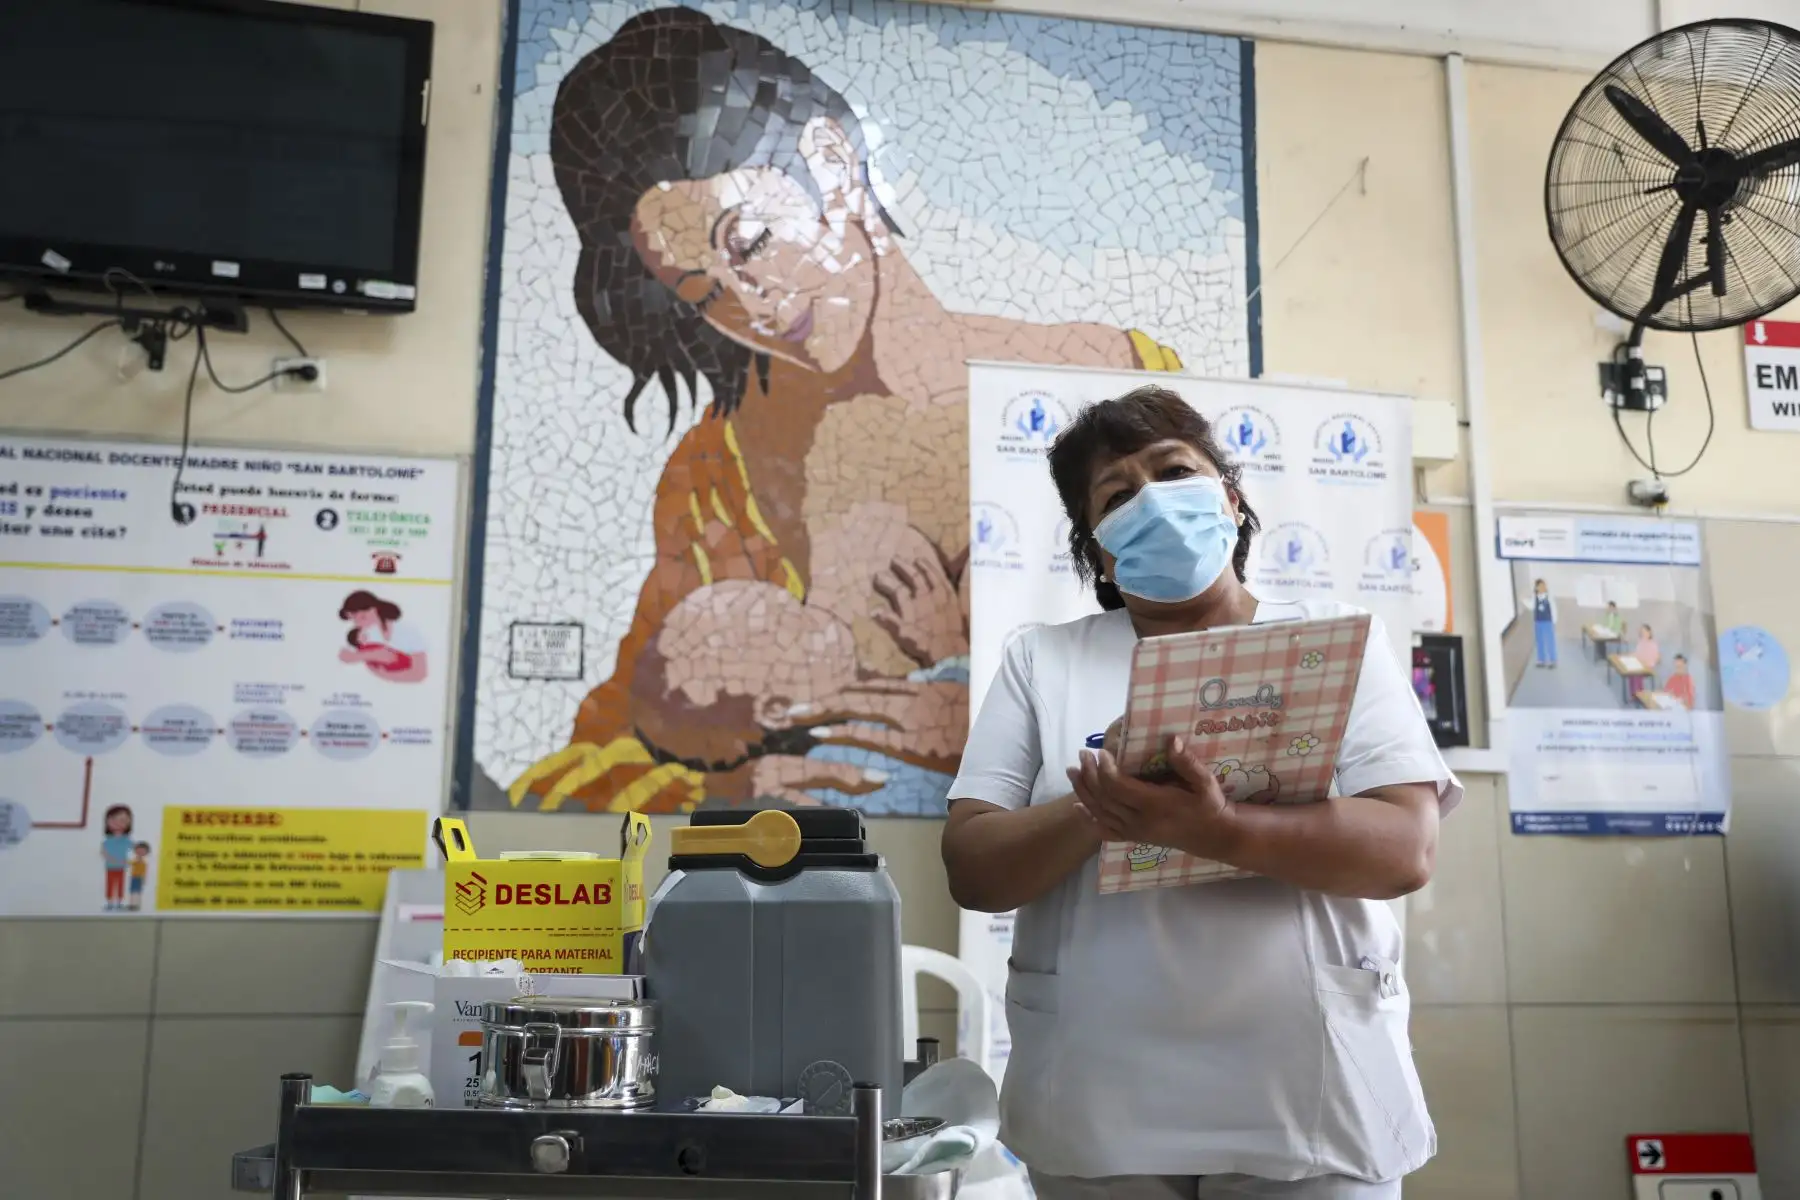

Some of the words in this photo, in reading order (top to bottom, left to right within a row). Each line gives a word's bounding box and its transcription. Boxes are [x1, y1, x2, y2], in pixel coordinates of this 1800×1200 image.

[1772, 402, 1800, 416] WI
[23, 448, 101, 464] NACIONAL
[109, 452, 182, 468] DOCENTE
[187, 457, 238, 470] MADRE
[495, 883, 612, 905] DESLAB
[453, 949, 518, 960] RECIPIENTE
[521, 949, 552, 960] PARA
[555, 949, 613, 960] MATERIAL
